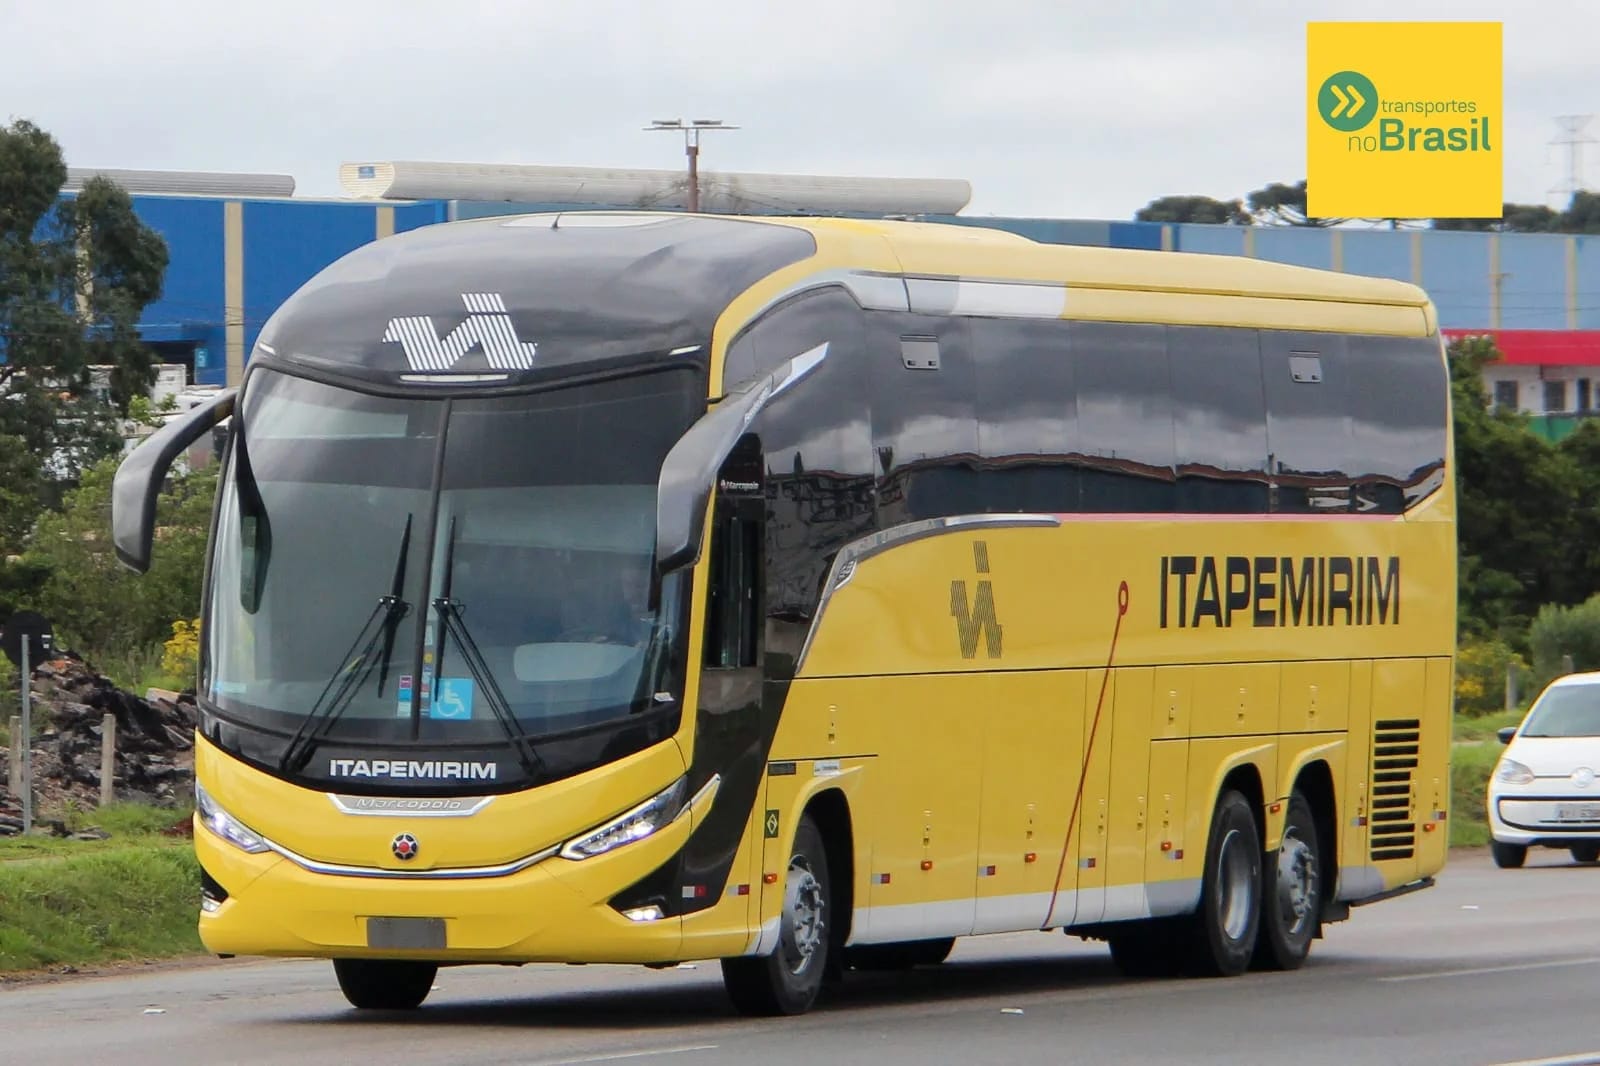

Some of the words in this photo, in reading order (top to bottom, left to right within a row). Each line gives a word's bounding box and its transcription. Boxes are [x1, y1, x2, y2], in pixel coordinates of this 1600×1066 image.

[1160, 556, 1400, 629] ITAPEMIRIM
[329, 759, 497, 780] ITAPEMIRIM
[355, 797, 462, 810] Marcopolo
